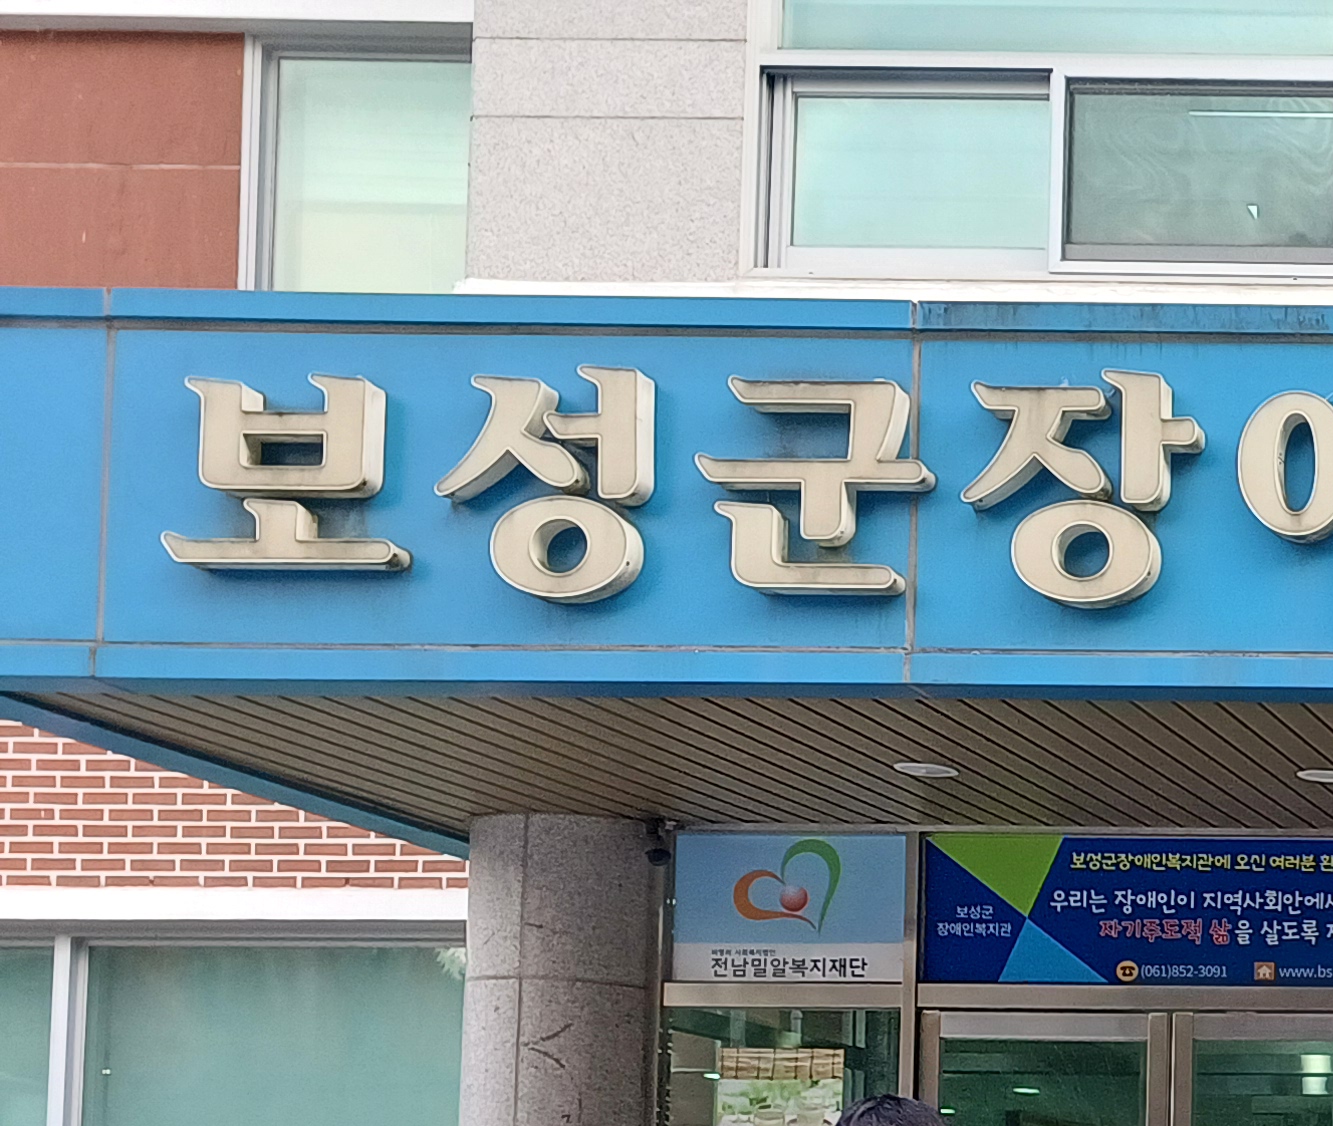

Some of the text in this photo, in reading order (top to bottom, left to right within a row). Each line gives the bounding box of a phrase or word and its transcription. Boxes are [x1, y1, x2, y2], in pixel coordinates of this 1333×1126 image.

[1070, 852, 1231, 871] 보성군장애인복지관에
[1234, 854, 1266, 872] 오신
[1269, 854, 1316, 872] 여러분
[956, 904, 994, 920] 보성군
[1050, 889, 1108, 914] 우리는
[1114, 889, 1195, 915] 장애인이
[936, 922, 1012, 938] 장애인복지관
[1099, 918, 1203, 945] 자기주도적
[1260, 918, 1320, 947] 살도록
[711, 956, 868, 978] 전남밀알복지재단
[1140, 964, 1228, 979] (061)852-3091
